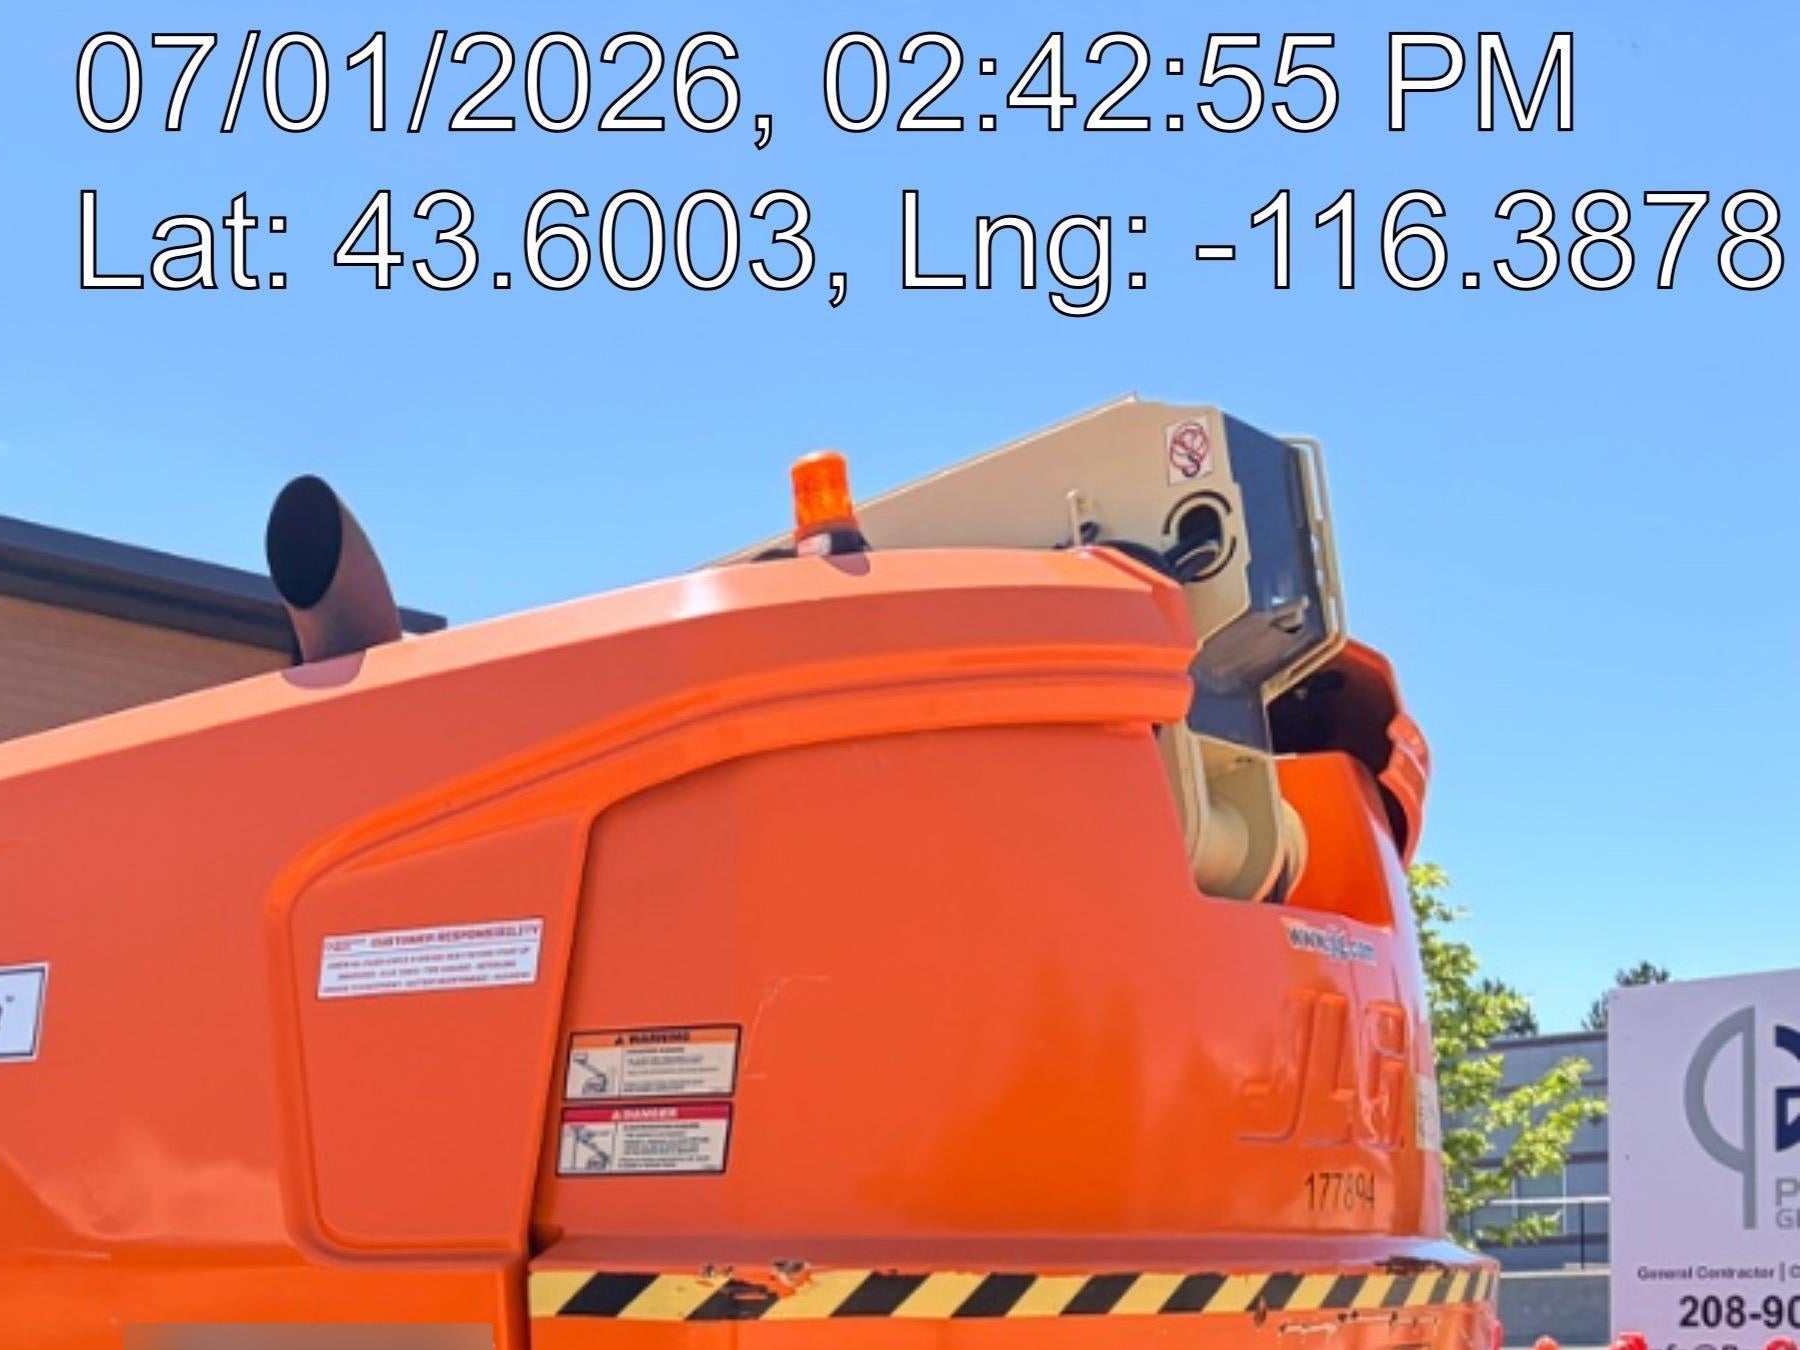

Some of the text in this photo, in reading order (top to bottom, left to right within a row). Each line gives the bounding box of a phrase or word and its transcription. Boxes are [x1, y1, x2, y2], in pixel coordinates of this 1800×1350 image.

[1303, 1171, 1375, 1212] 177894
[1637, 1265, 1692, 1281] General
[1696, 1265, 1774, 1280] Contractor
